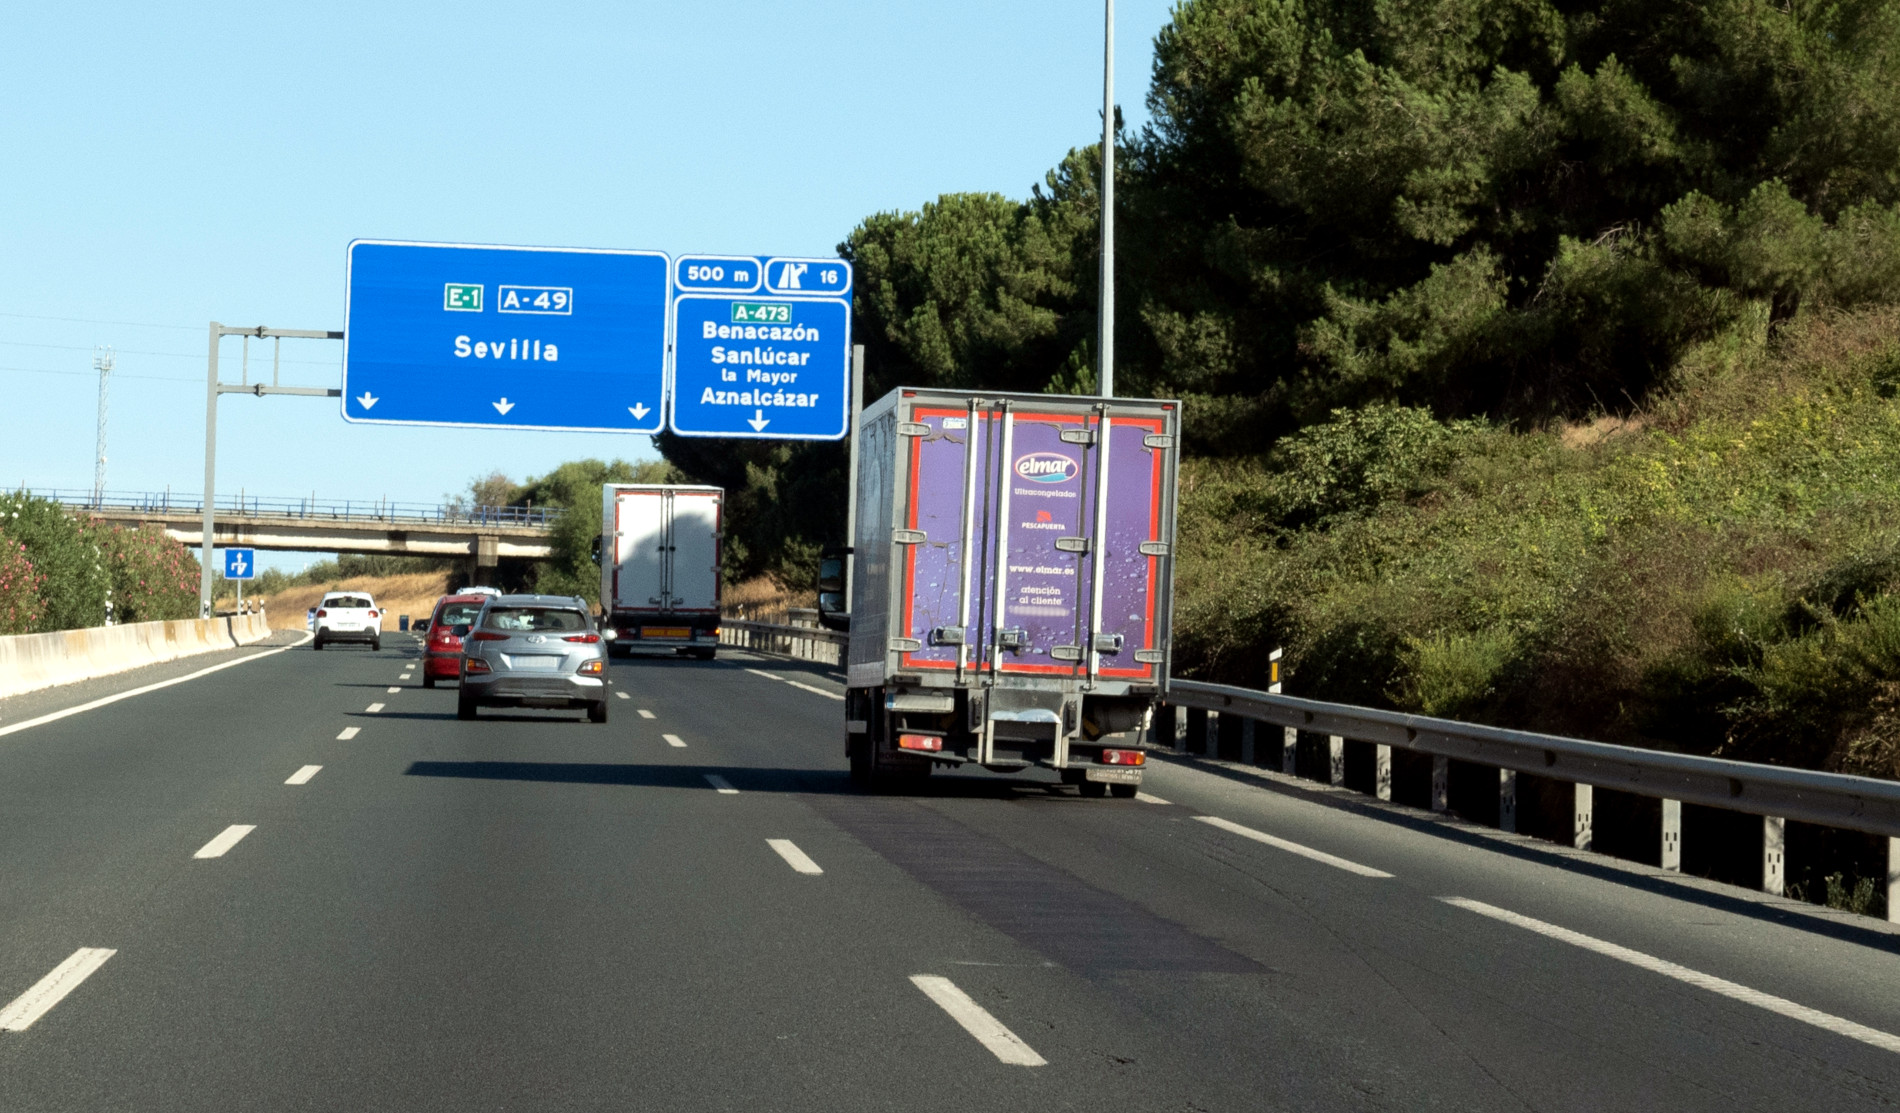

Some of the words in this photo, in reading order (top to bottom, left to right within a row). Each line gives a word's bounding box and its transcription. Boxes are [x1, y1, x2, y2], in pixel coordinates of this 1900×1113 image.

[688, 266, 724, 281] 500
[733, 270, 749, 282] m
[820, 270, 838, 284] 16
[449, 288, 479, 307] E-1
[503, 290, 568, 310] A-49
[735, 306, 789, 321] A-473
[702, 321, 820, 342] Benacazón
[454, 335, 559, 362] Sevilla
[711, 346, 810, 366] Sanlúcar
[721, 368, 737, 382] la
[746, 369, 798, 386] Mayor
[700, 387, 819, 407] Aznalcázar
[1019, 457, 1071, 474] elmar
[1014, 488, 1077, 498] Ultracongelados
[1021, 522, 1066, 531] PESCAPUERTA
[1009, 565, 1075, 575] www.elmar.es
[1020, 586, 1061, 595] atención
[1019, 596, 1029, 604] al
[1031, 596, 1062, 605] cliente
